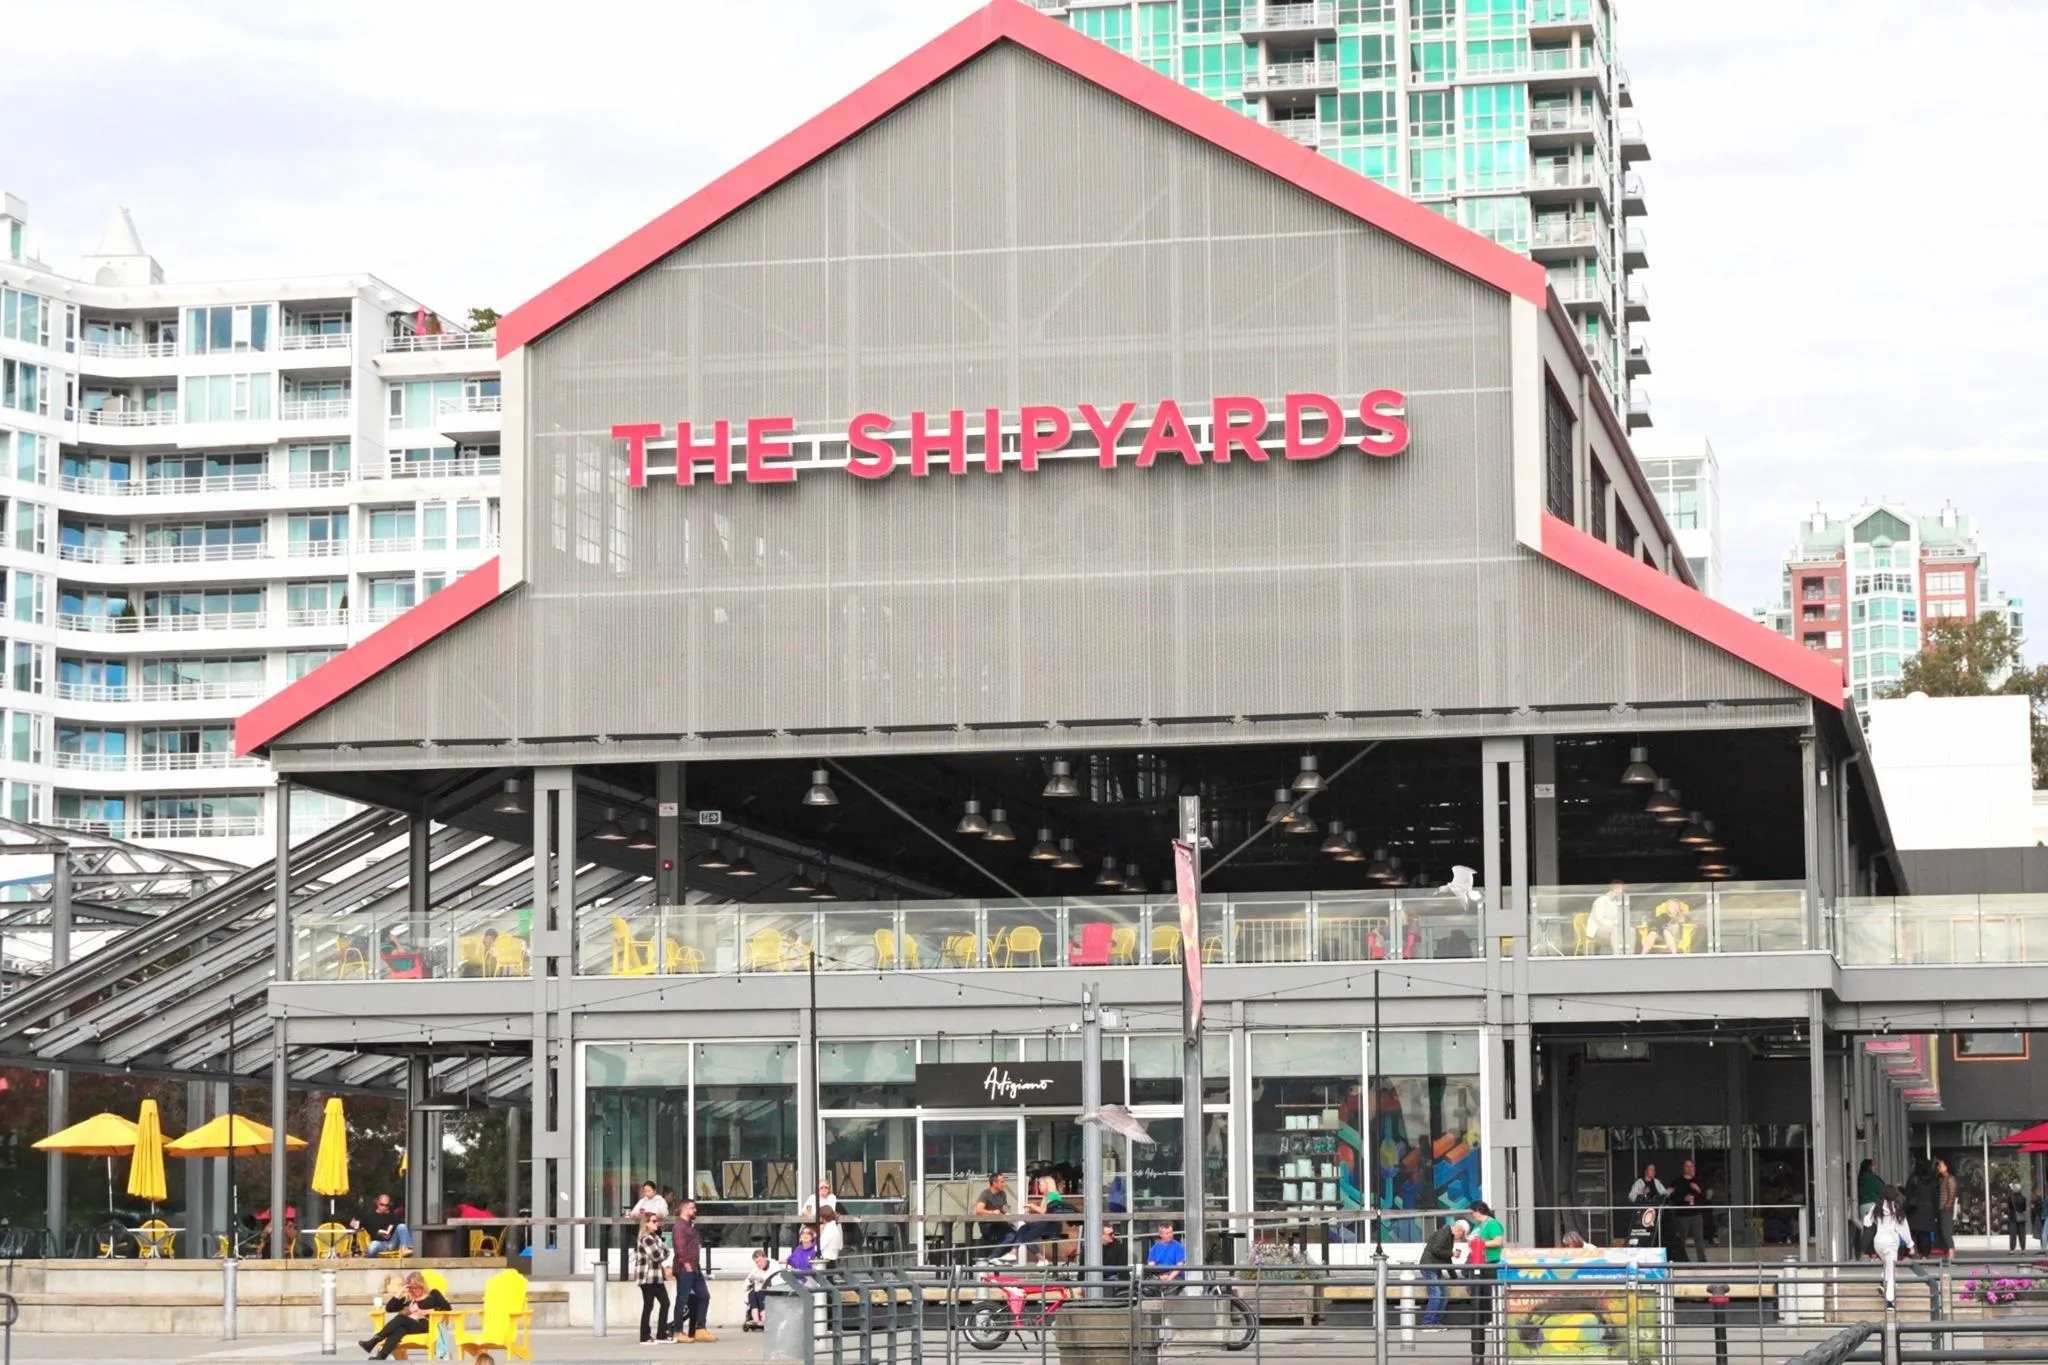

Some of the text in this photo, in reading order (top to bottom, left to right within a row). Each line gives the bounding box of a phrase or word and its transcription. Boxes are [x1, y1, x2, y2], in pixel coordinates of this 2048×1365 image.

[610, 388, 1410, 488] THE SHIPYARDS
[984, 1066, 1054, 1100] Artigiano
